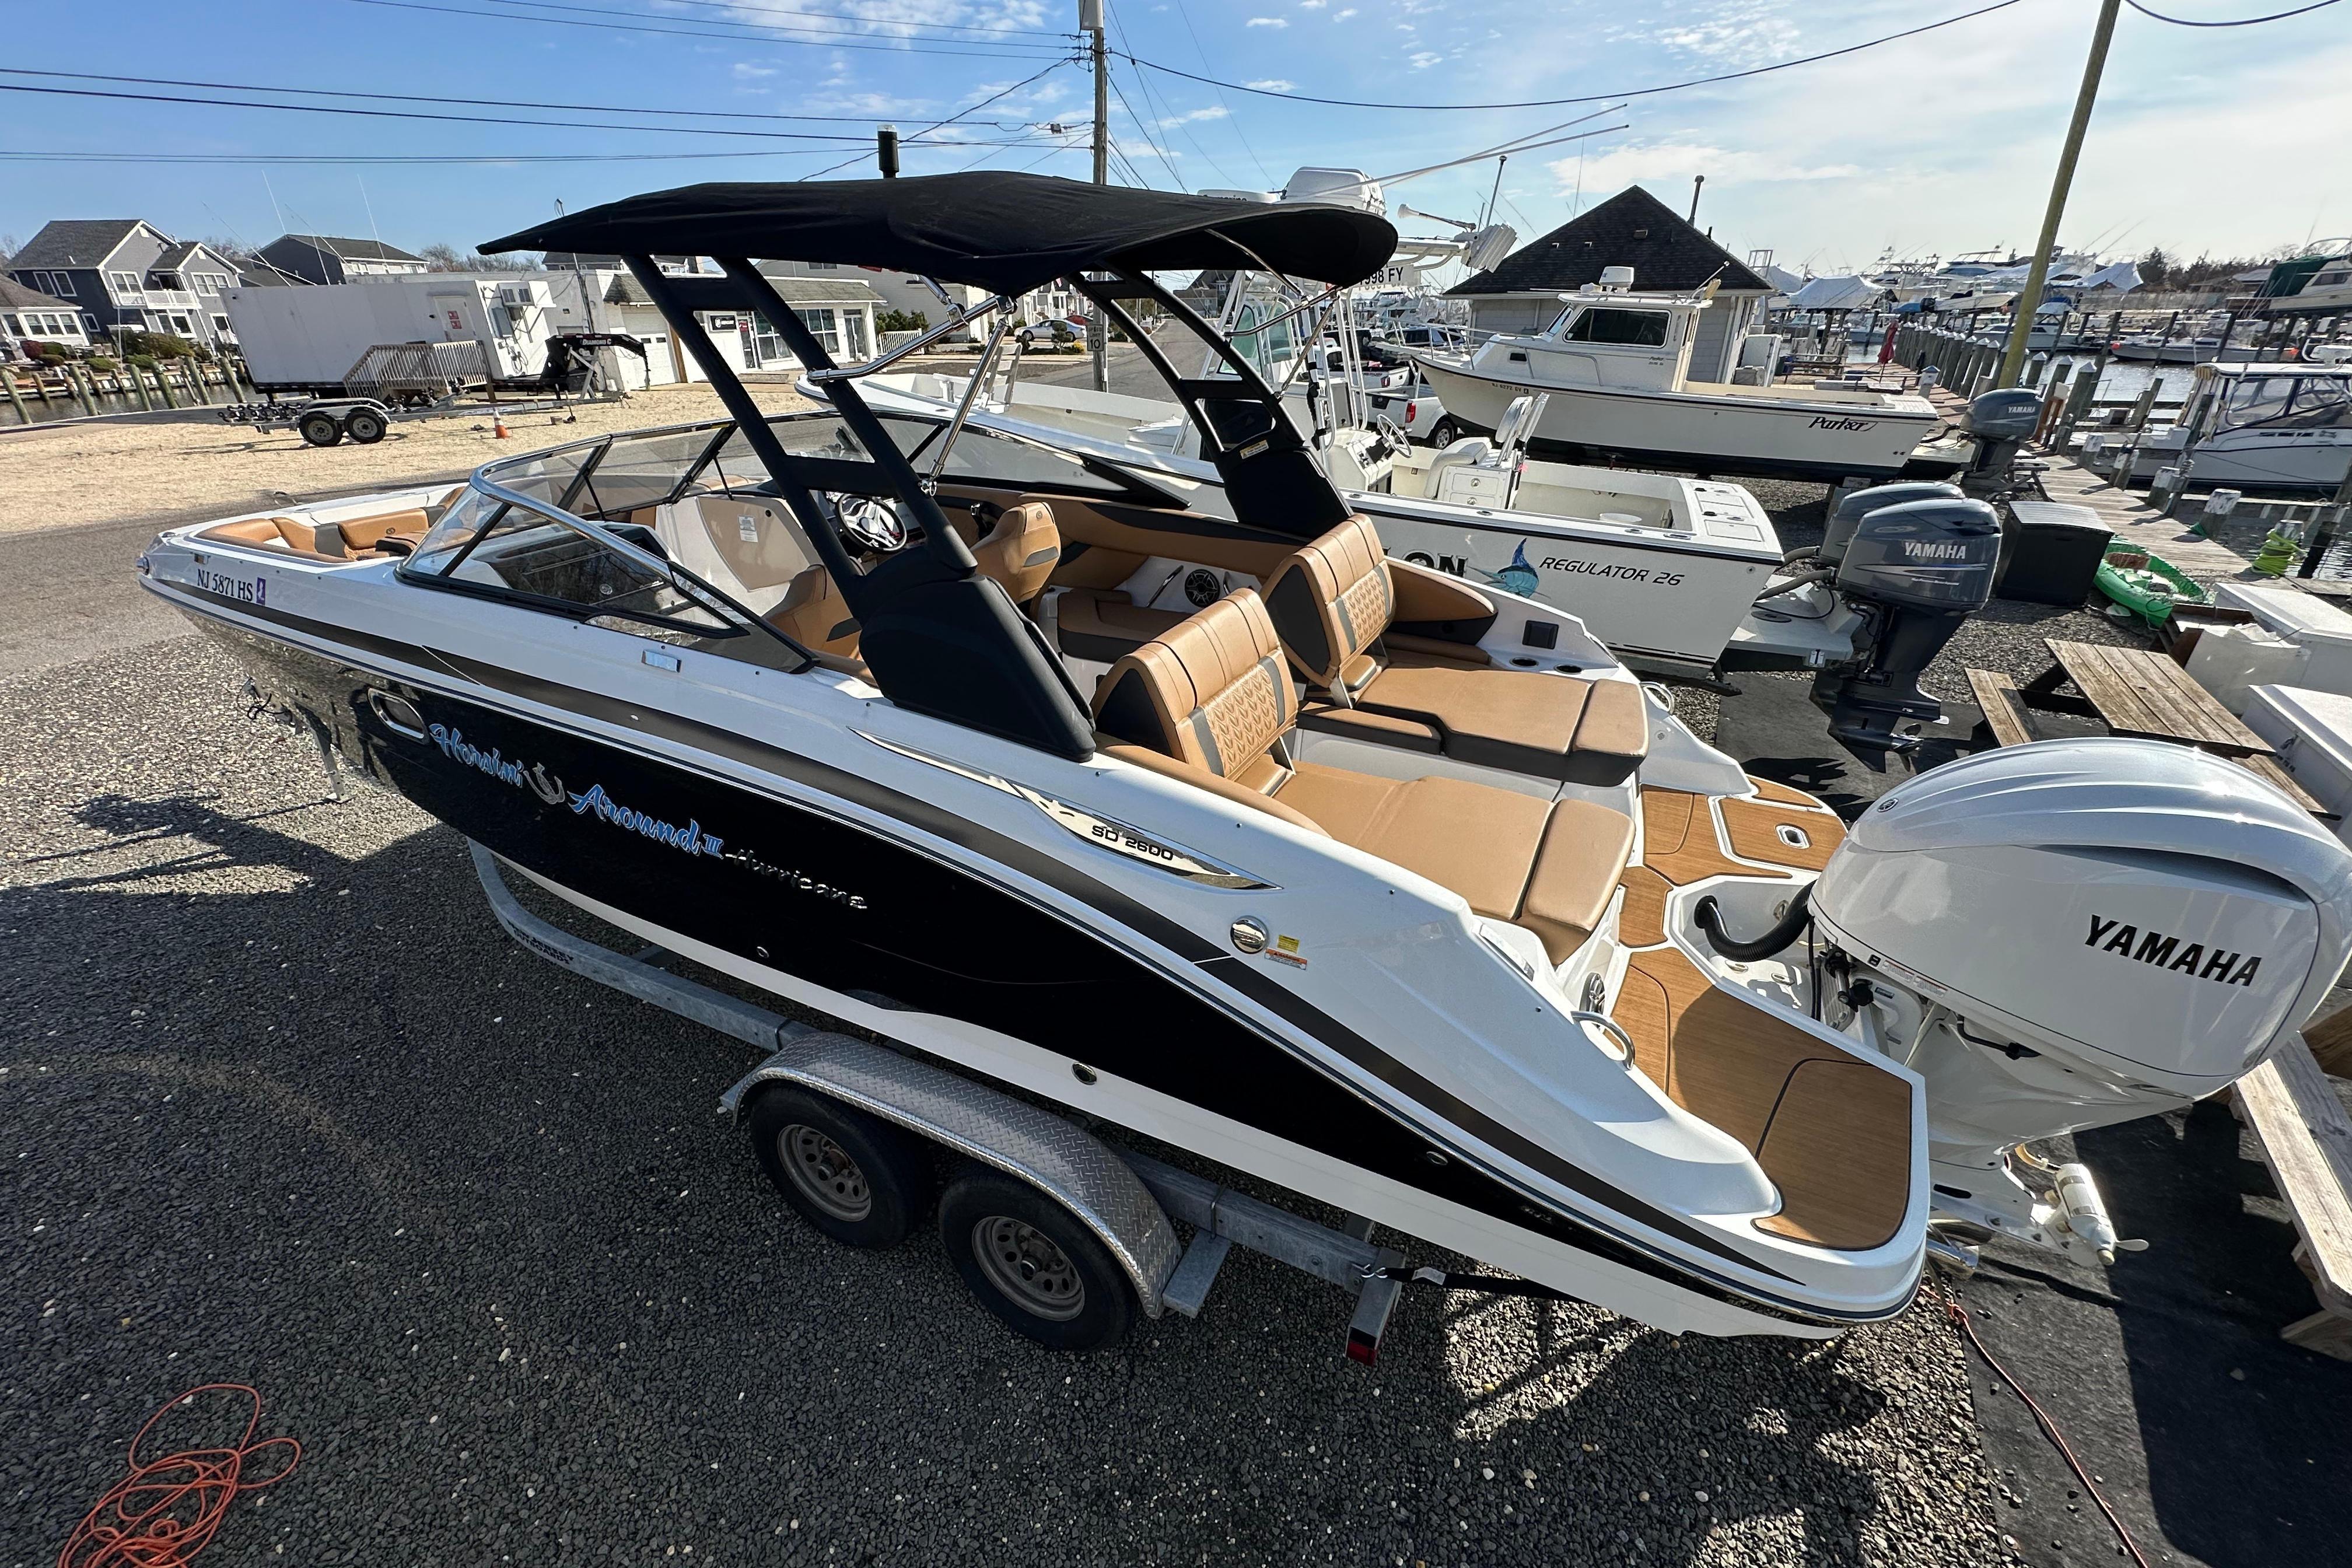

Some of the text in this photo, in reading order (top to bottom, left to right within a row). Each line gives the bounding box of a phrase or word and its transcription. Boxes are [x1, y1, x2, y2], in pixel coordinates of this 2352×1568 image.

[1360, 267, 1404, 285] 98 FY
[1090, 339, 1100, 349] 10
[1808, 416, 1869, 431] Parker
[1382, 547, 1469, 579] ON
[1905, 542, 1966, 559] YAMAHA
[198, 569, 253, 601] NJ 5871 HS
[1539, 557, 1685, 586] REGULATOR 26
[567, 783, 701, 857] Around
[1091, 825, 1174, 861] SD 2600
[725, 849, 867, 909] Hurricane
[2084, 914, 2262, 986] YAMAHA
